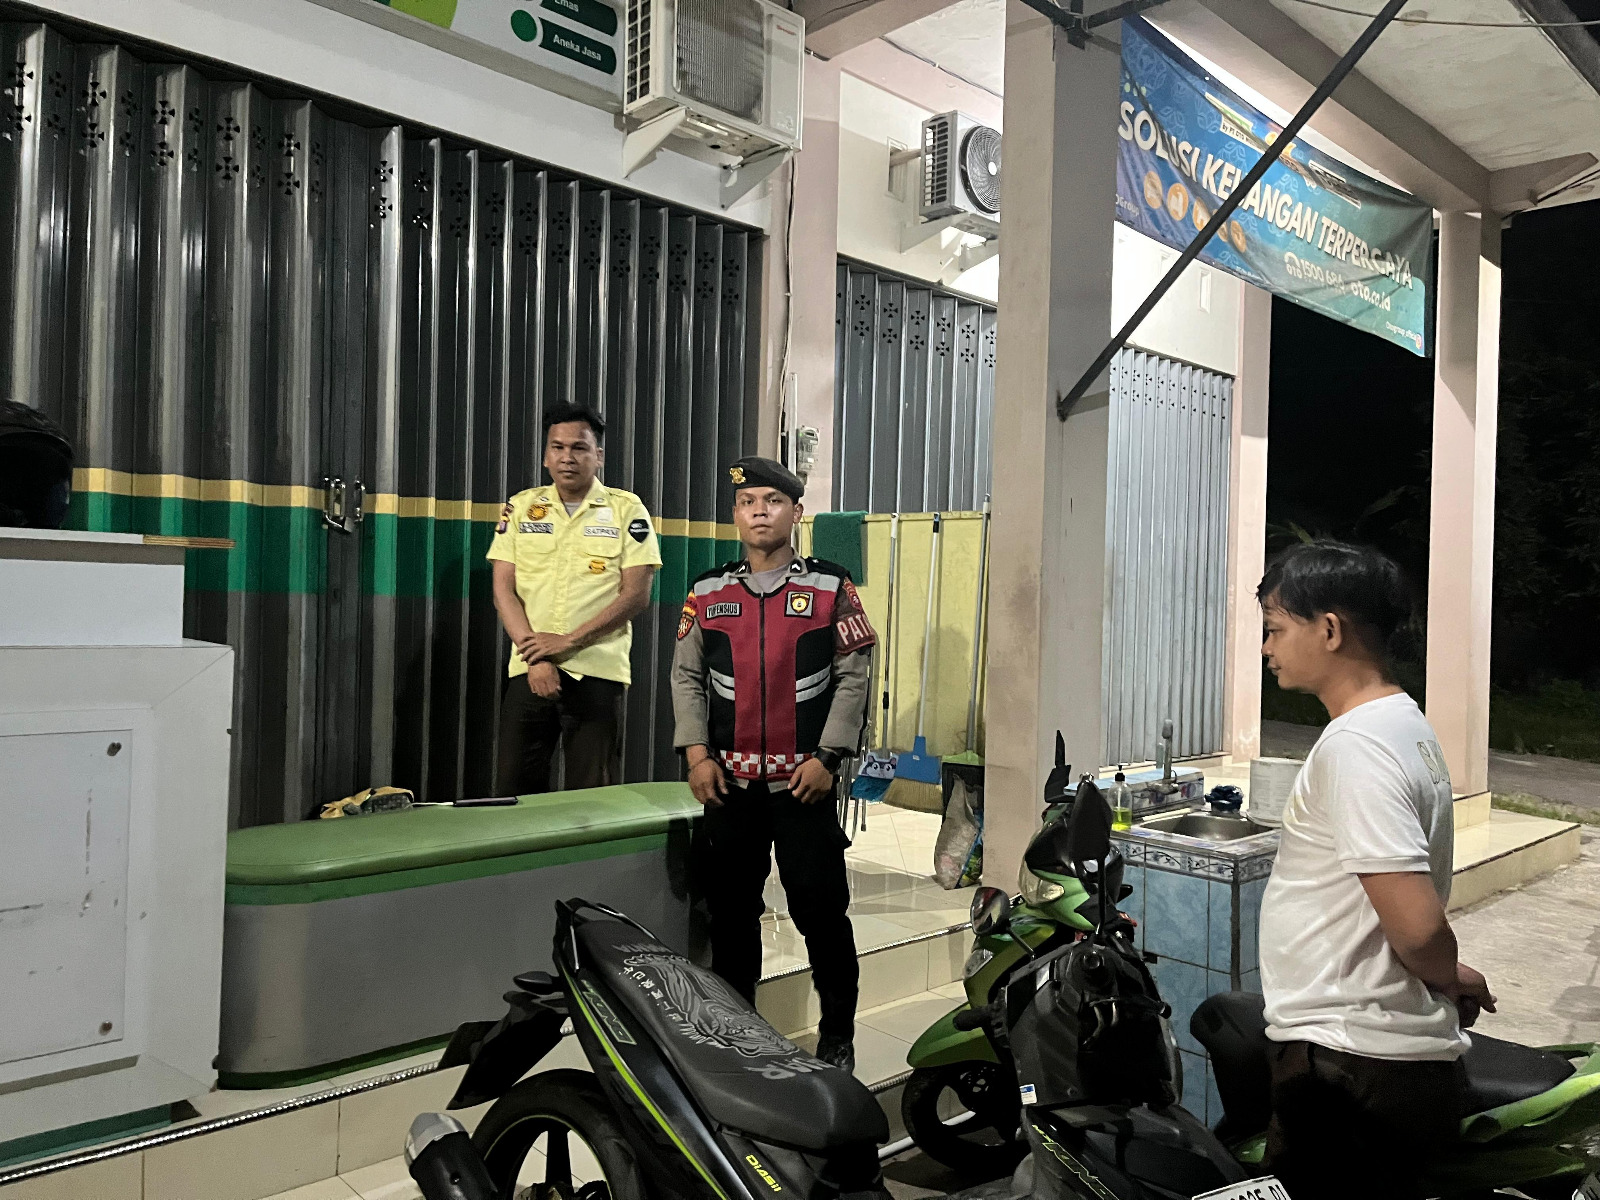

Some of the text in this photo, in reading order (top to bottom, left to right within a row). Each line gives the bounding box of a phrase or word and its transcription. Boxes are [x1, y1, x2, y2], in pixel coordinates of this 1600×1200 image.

[553, 34, 602, 61] Aneka Jasa
[1118, 101, 1200, 182] SOLUSI
[1318, 216, 1413, 290] TERPERCAYA
[1301, 259, 1325, 283] 1500
